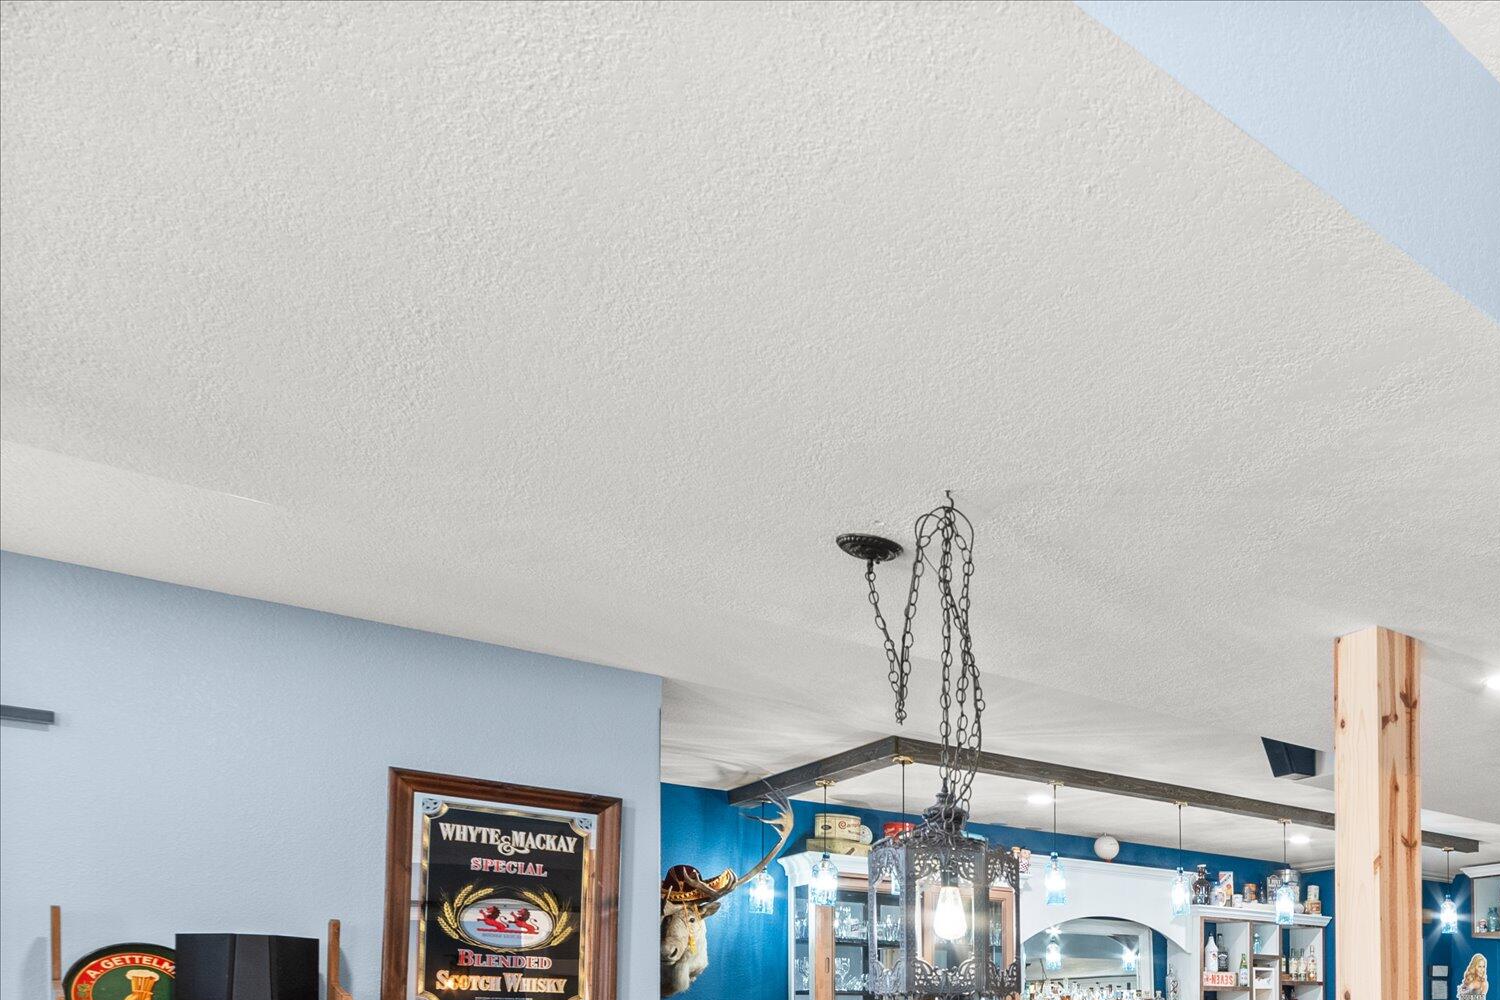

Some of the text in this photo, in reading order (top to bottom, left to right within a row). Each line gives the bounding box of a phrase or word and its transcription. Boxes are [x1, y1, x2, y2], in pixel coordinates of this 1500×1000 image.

[438, 822, 578, 856] WHYTE & MACKAY
[470, 857, 548, 878] SPECIAL
[101, 955, 176, 975] GETTELM
[457, 948, 553, 970] BLENDED
[435, 969, 568, 994] SCOTCH WHISKY
